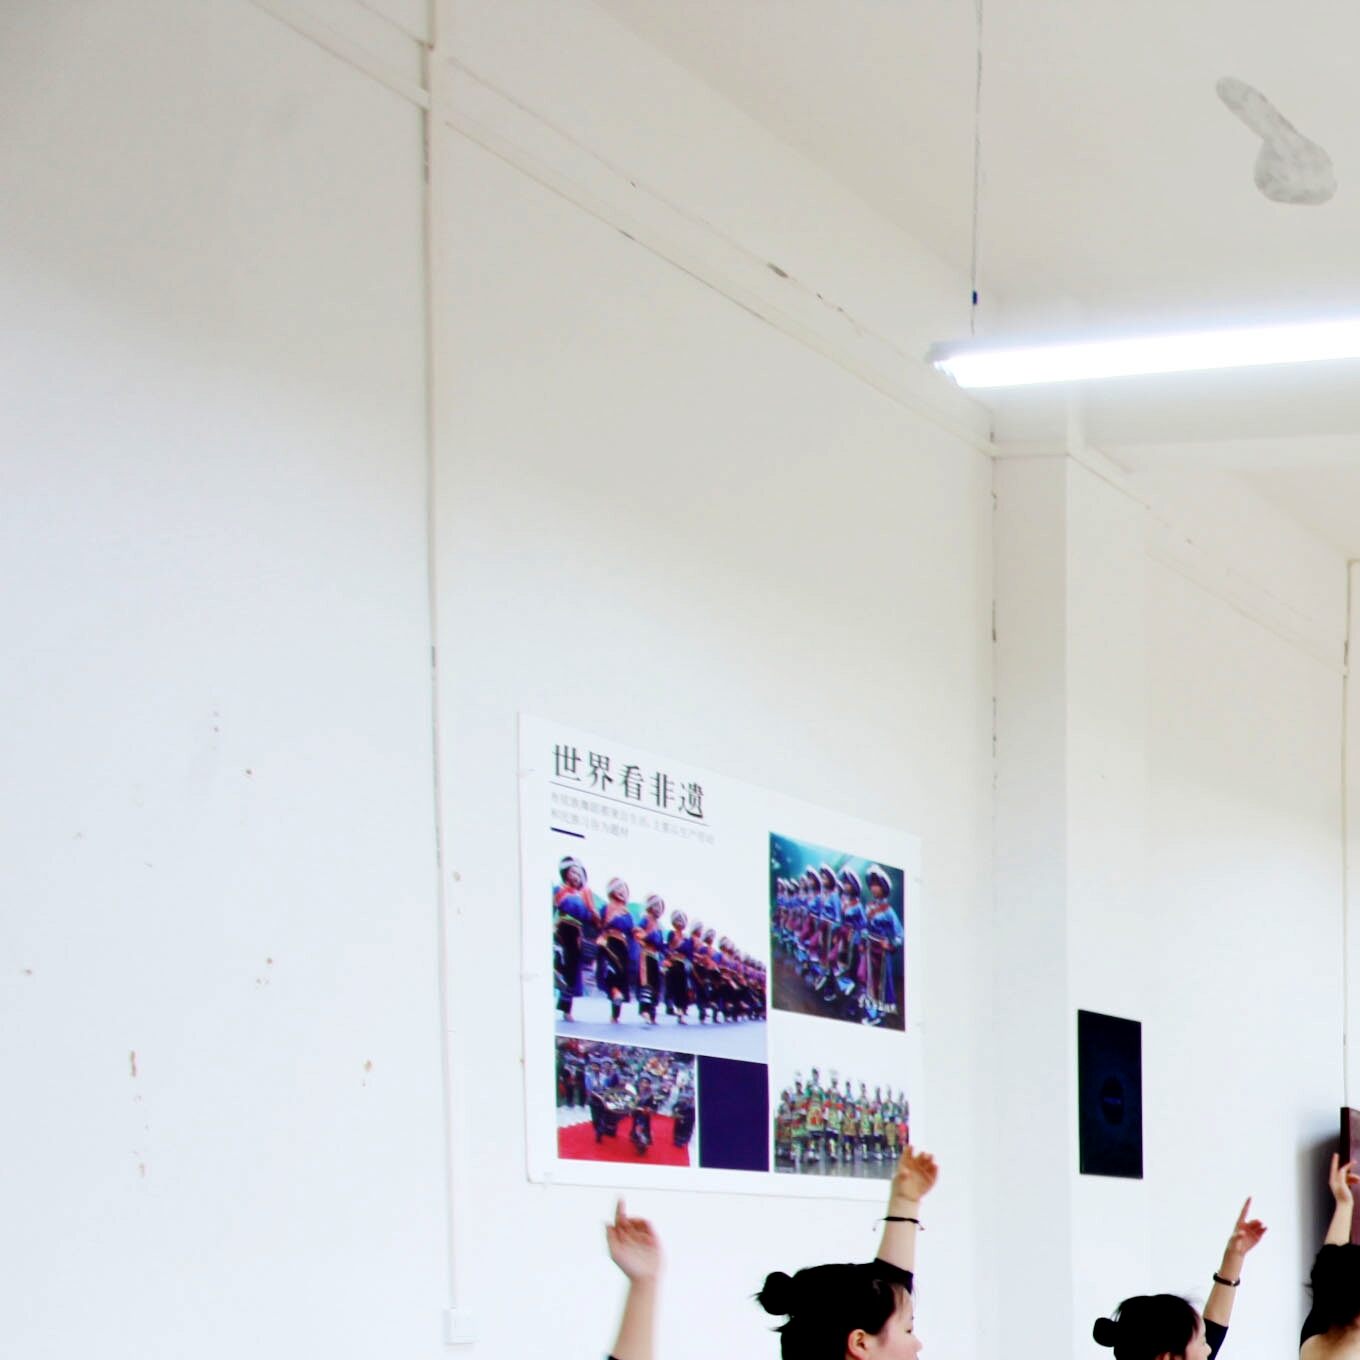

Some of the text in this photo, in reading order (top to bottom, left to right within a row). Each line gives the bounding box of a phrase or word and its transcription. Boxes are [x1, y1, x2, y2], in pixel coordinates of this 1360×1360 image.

[552, 744, 704, 819] 世界看非遗
